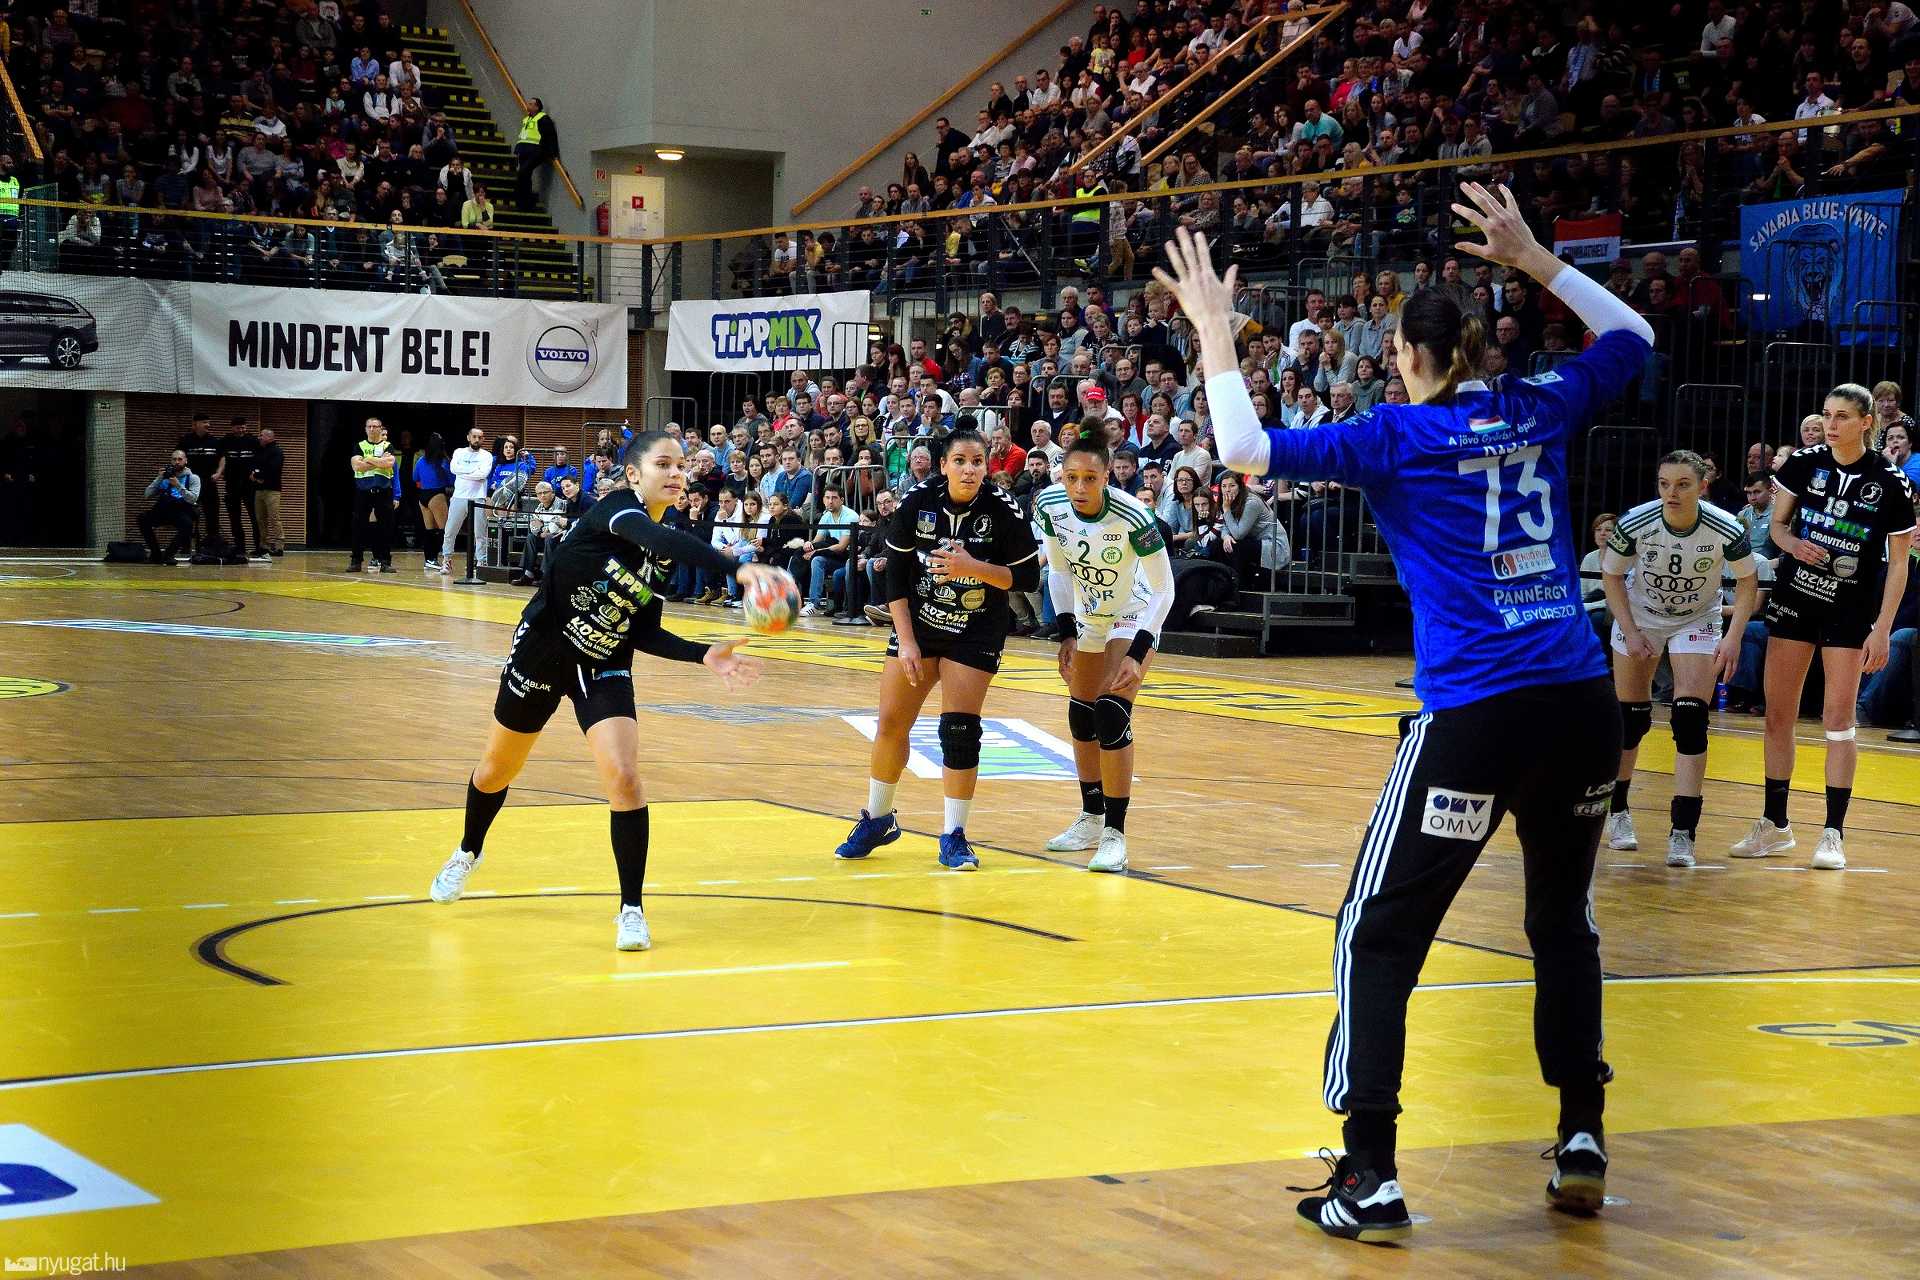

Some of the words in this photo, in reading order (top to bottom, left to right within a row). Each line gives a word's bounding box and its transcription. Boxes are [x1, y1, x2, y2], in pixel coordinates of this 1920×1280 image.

[1749, 207, 1800, 252] SAVARIA
[1803, 202, 1887, 240] BLUE-WHITE
[228, 319, 390, 373] MINDENT
[401, 327, 490, 377] BELE!
[537, 348, 588, 361] VOLVO
[1458, 445, 1554, 552] 73
[1824, 496, 1850, 518] 19
[1077, 540, 1091, 564] 2
[1810, 530, 1860, 552] GRAVITÁCIÓ
[1668, 554, 1683, 575] 8
[1795, 566, 1838, 591] KOZMA
[1078, 579, 1115, 601] YOR
[921, 602, 969, 623] KOZMA
[570, 616, 620, 649] KOZMA
[524, 679, 551, 692] ABLAK
[1430, 815, 1483, 835] OMV
